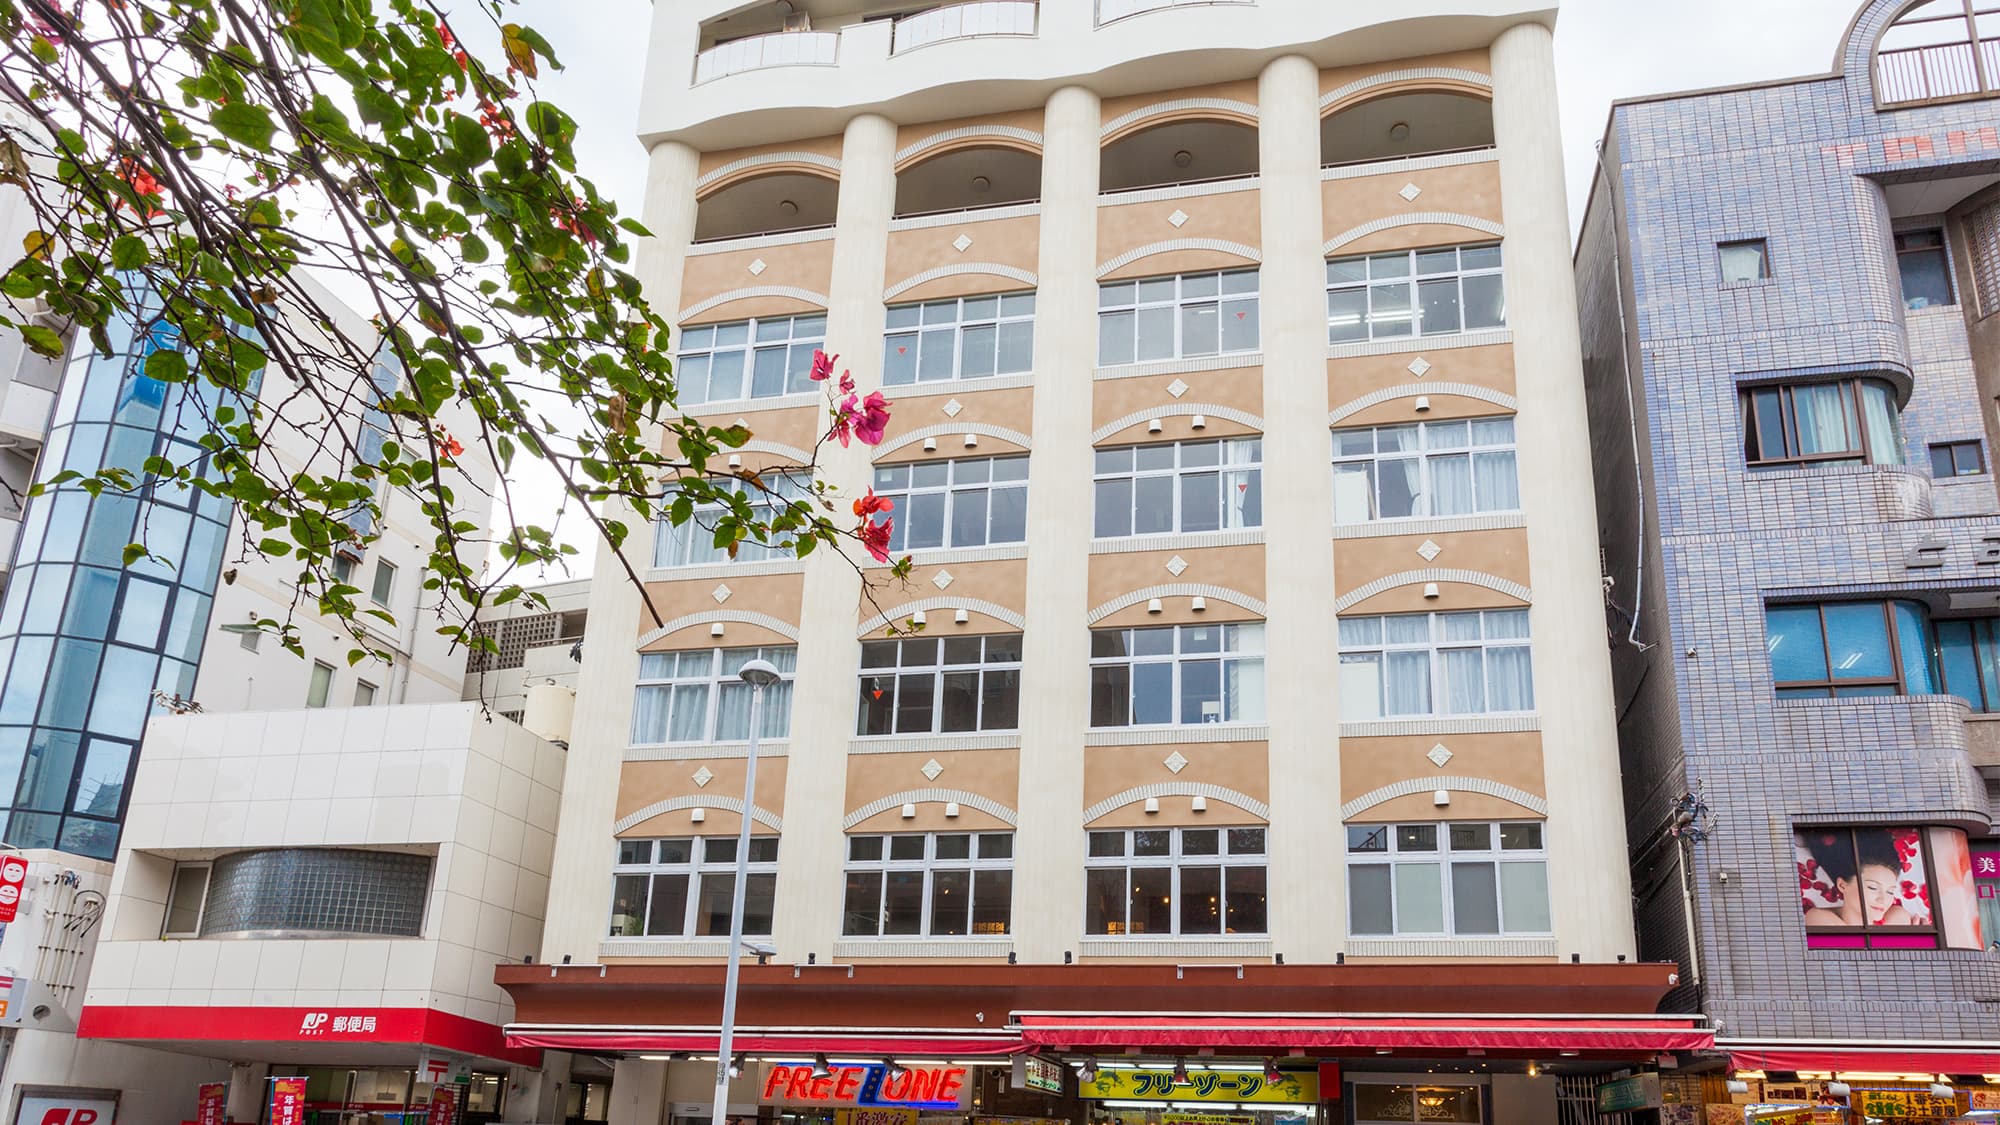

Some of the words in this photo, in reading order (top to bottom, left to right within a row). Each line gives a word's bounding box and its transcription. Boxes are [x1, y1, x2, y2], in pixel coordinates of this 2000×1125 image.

[332, 1016, 376, 1033] 郵便局
[764, 1066, 864, 1100] FREE
[1132, 1072, 1263, 1097] フリーゾーン
